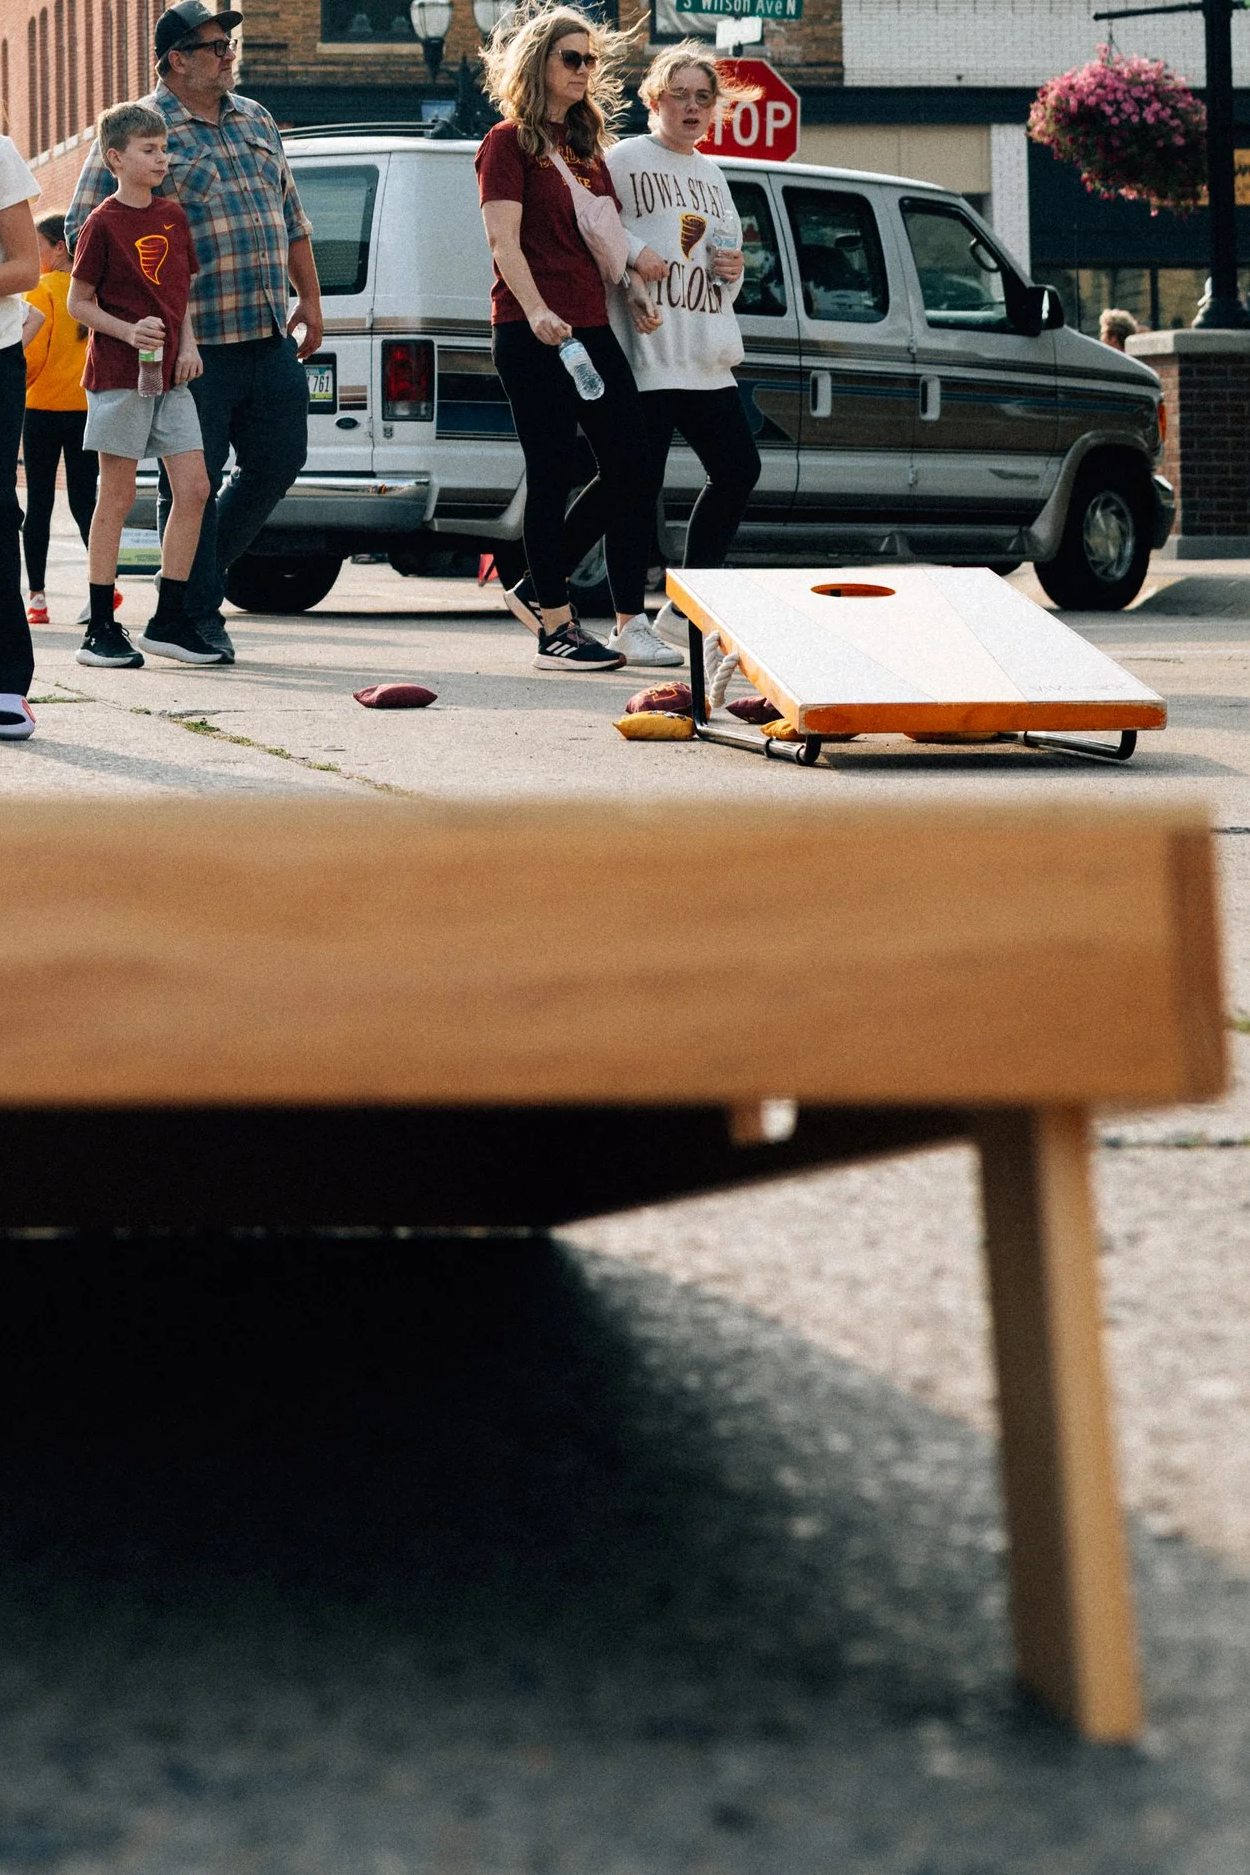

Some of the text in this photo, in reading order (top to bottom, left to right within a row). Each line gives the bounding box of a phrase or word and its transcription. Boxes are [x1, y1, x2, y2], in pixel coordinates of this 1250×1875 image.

[714, 100, 792, 147] TOP
[630, 171, 687, 218] IOWA
[313, 375, 329, 392] 761
